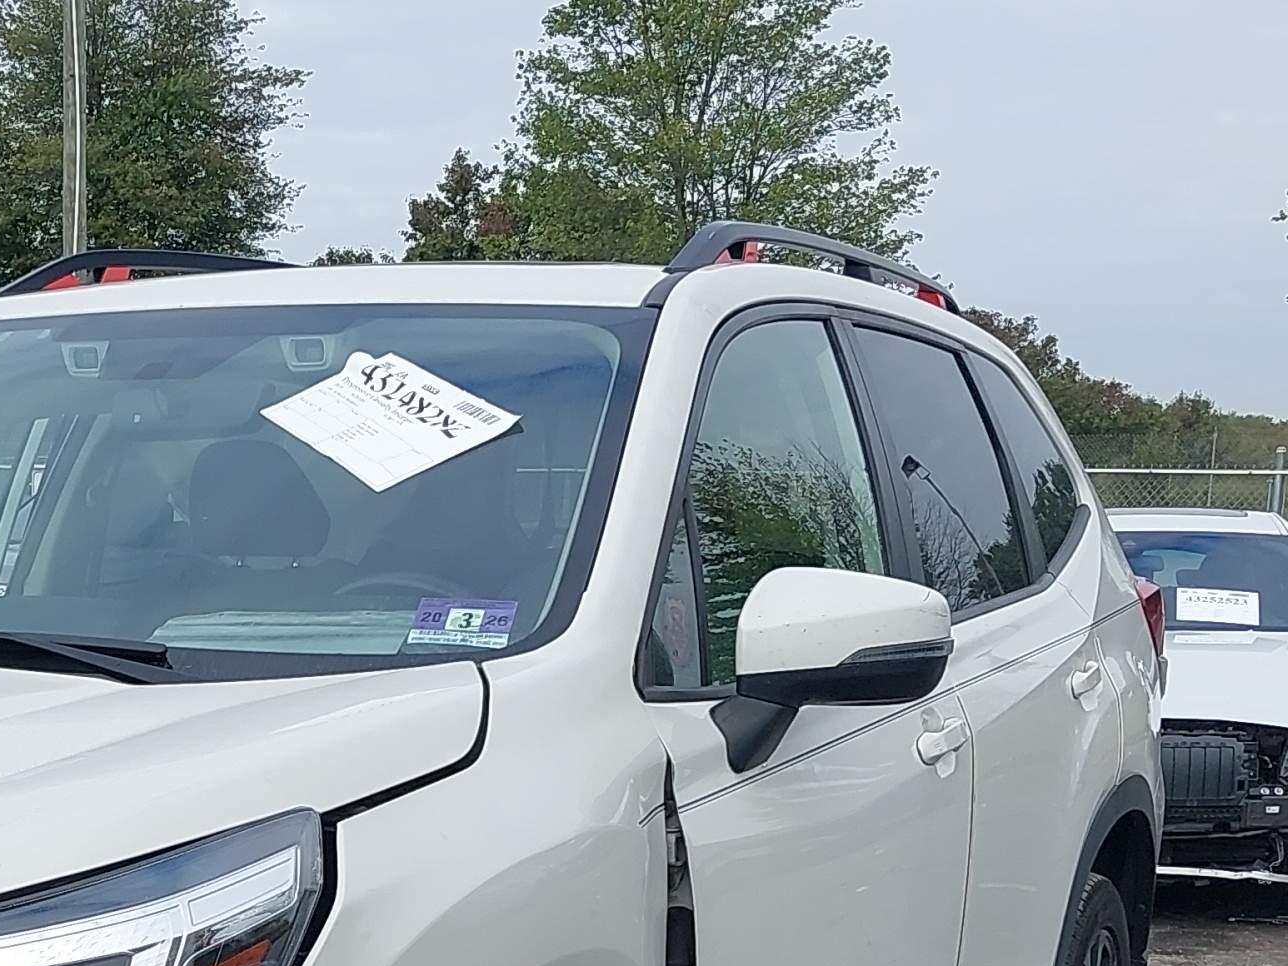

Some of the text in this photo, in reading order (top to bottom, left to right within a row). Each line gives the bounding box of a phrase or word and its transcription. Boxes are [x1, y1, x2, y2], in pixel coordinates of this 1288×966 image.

[420, 611, 510, 629] 20 3 26
